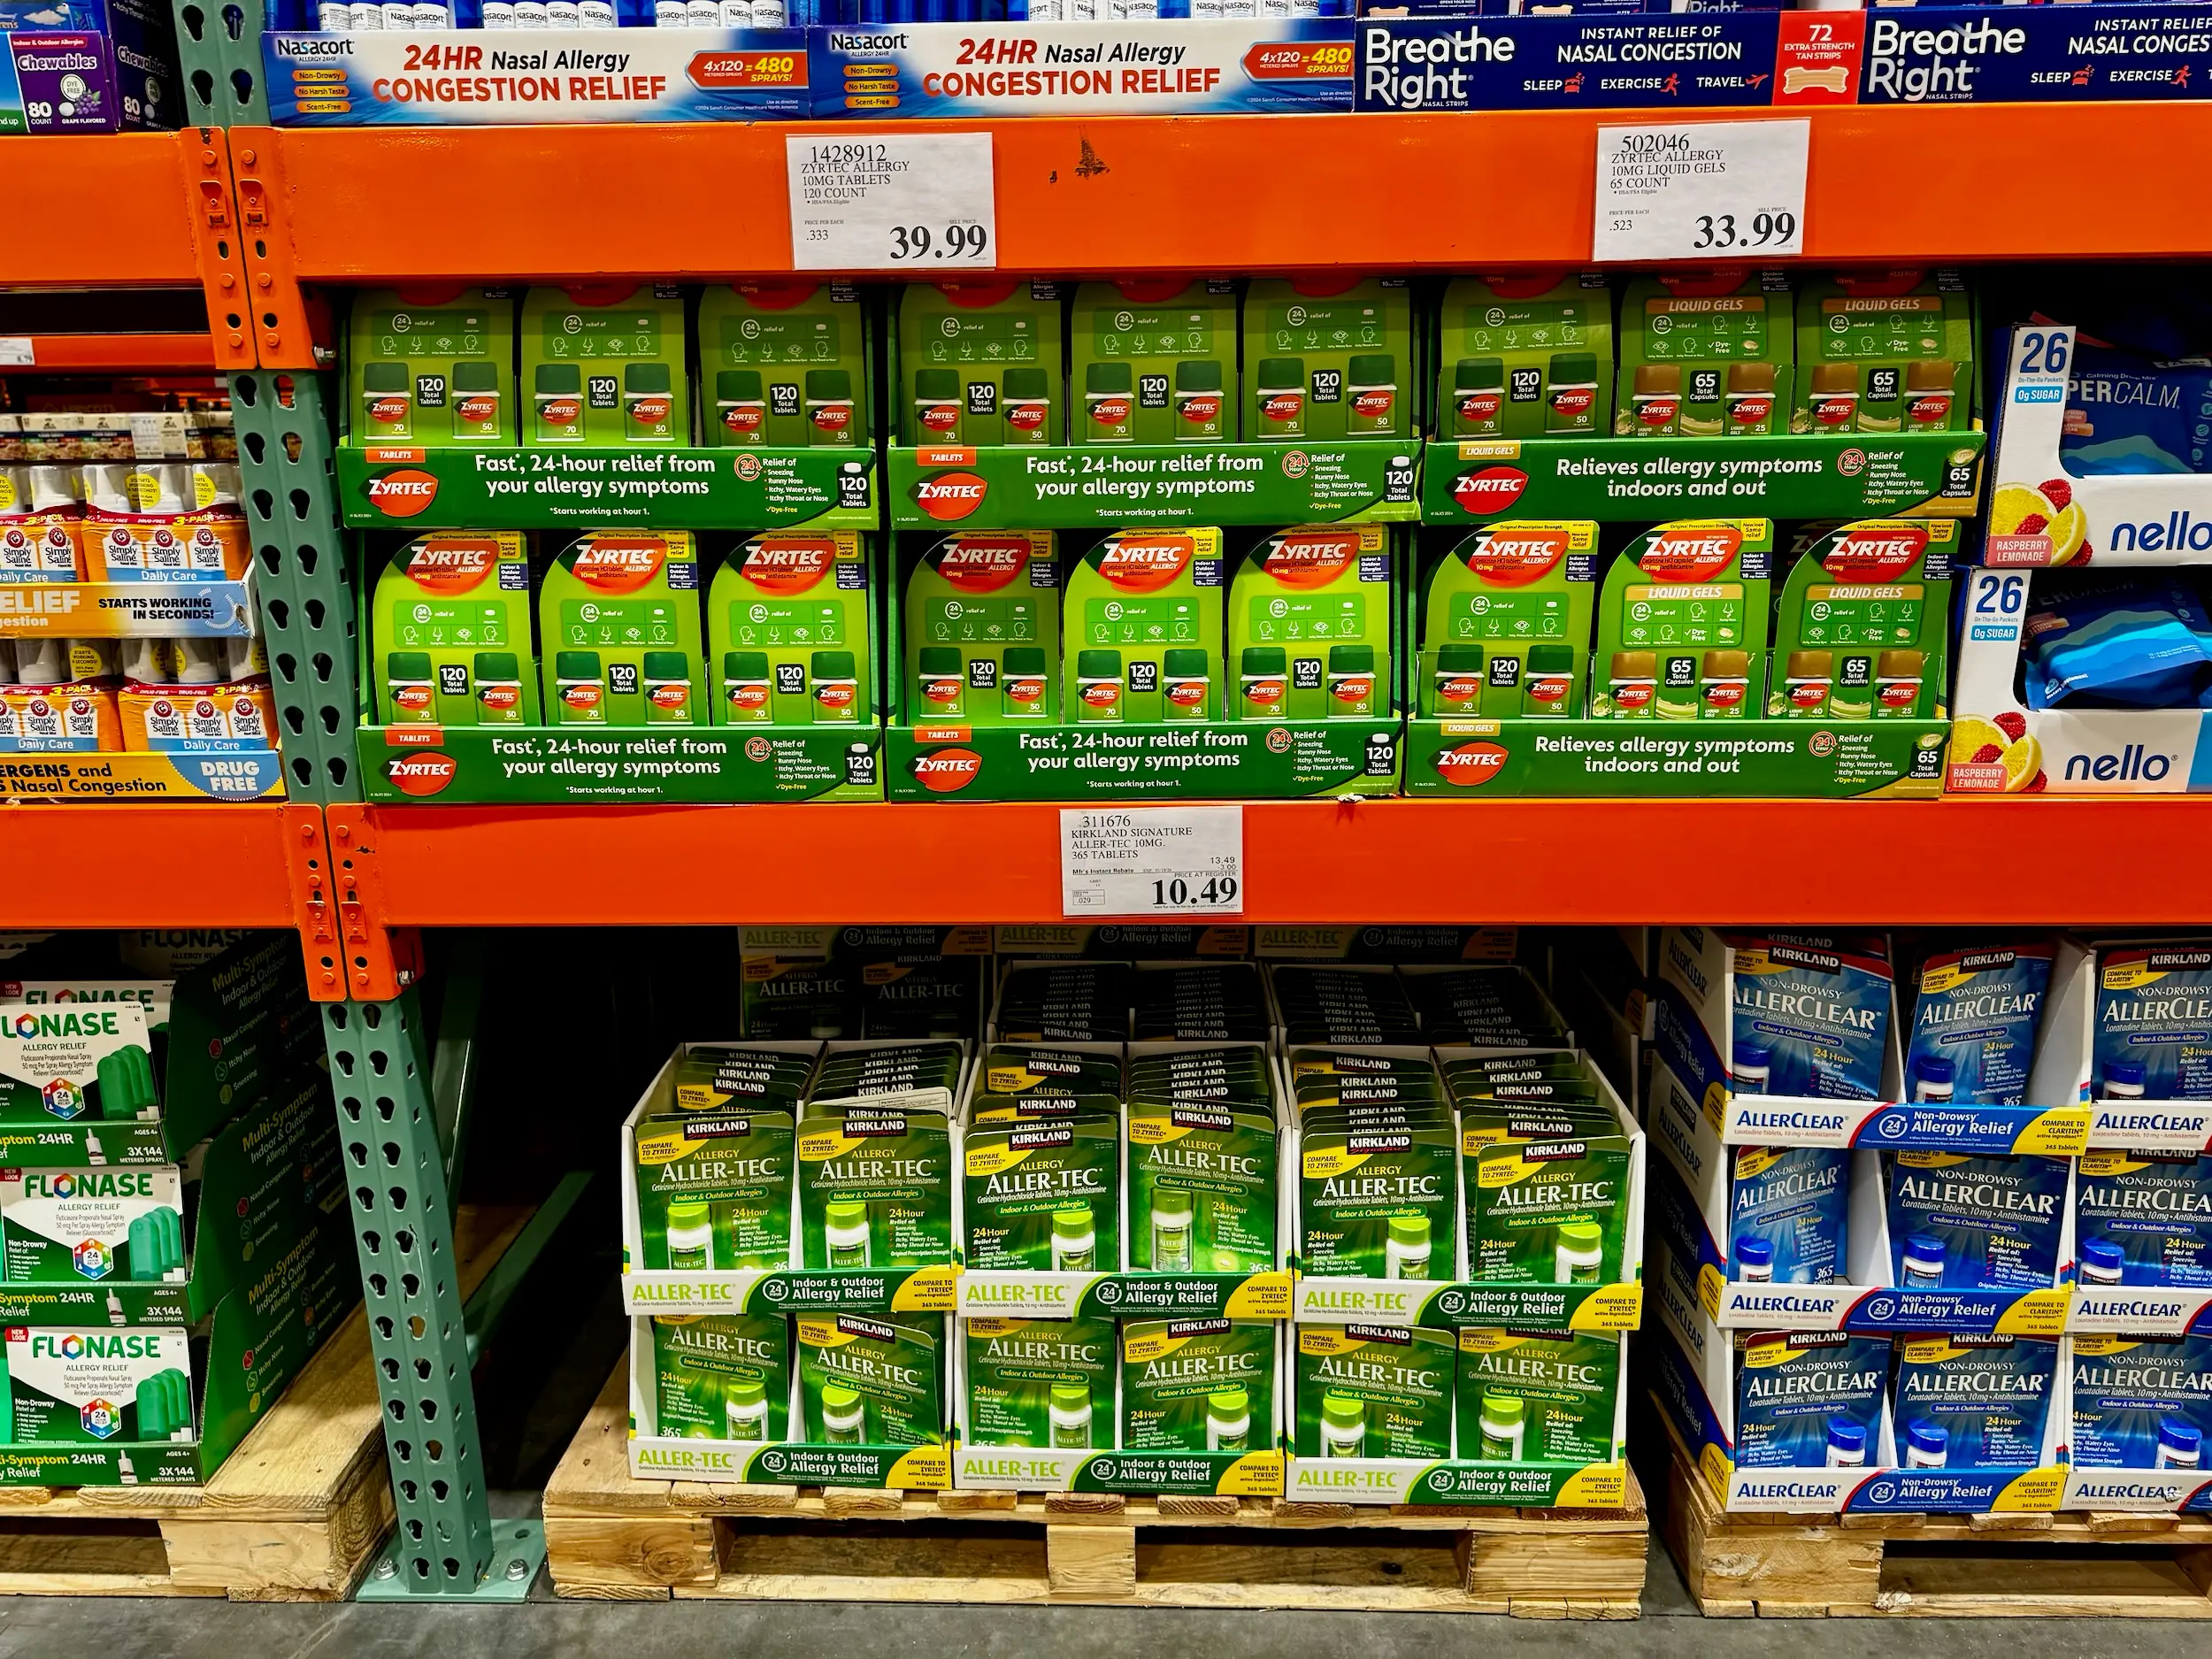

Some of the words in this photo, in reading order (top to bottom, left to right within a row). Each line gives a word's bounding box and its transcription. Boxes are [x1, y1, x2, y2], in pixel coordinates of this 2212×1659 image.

[1581, 27, 1644, 40] INSTANT
[1648, 27, 1699, 38] RELIEF
[1702, 26, 1722, 37] OF
[1809, 25, 1832, 42] 72
[278, 39, 353, 57] Nasacort
[831, 34, 907, 51] Nasacort
[1365, 26, 1515, 64] Breathe
[403, 44, 482, 72] 24HR
[491, 50, 547, 71] Nasal
[554, 50, 630, 73] Allergy
[1557, 43, 1617, 63] NASAL
[1622, 42, 1741, 62] CONGESTION
[18, 53, 97, 71] Chewables
[703, 60, 743, 73] 4x120
[754, 58, 795, 74] 480
[750, 73, 793, 83] SPRAYS!
[1524, 80, 1563, 91] SLEEP
[1601, 77, 1662, 89] EXERCISE
[1697, 76, 1745, 88] TRAVEL
[373, 79, 561, 103] CONGESTION
[571, 76, 665, 101] RELIEF
[1365, 64, 1467, 109] Right
[28, 102, 52, 118] 80
[1621, 134, 1690, 153] 502046
[811, 144, 887, 163] 1428912
[1611, 153, 1661, 164] ZYRTEC
[1665, 150, 1724, 162] ALLERGY
[802, 163, 849, 173] ZYRTEC
[854, 161, 910, 173] ALLERGY
[1612, 166, 1643, 176] 10MG
[1647, 165, 1690, 175] LIQUID
[1695, 163, 1725, 173] GELS
[803, 176, 833, 186] 10MG
[838, 174, 891, 185] TABLETS
[1610, 179, 1623, 189] 65
[1627, 178, 1670, 188] COUNT
[803, 188, 821, 198] 120
[825, 188, 867, 198] COUNT
[1609, 220, 1632, 231] .523
[1694, 212, 1795, 249] 33.99
[807, 230, 828, 241] .333
[890, 226, 987, 259] 39.99
[2019, 333, 2069, 373] 26
[2018, 390, 2029, 401] 0g
[2032, 389, 2060, 400] SUGAR
[1466, 448, 1494, 457] LIQUID
[1495, 447, 1514, 456] GELS
[530, 455, 606, 472] 24-hour
[611, 454, 664, 473] relief
[668, 455, 716, 472] from
[1556, 458, 1639, 477] Relieves
[1643, 457, 1716, 480] allergy
[1719, 457, 1823, 479] symptoms
[368, 480, 431, 495] ZYRTEC
[486, 480, 529, 497] your
[534, 476, 603, 497] allergy
[609, 479, 710, 498] symptoms
[839, 477, 867, 491] 120
[1609, 480, 1683, 497] indoors
[1688, 480, 1729, 496] and
[1733, 480, 1766, 495] out
[579, 507, 610, 517] working
[109, 545, 137, 560] Simply
[1472, 536, 1555, 557] ZYRTEC
[1996, 541, 2047, 551] RASPBERRY
[1997, 551, 2044, 562] LEMONADE
[142, 571, 169, 582] Daily
[172, 572, 196, 581] Care
[98, 598, 148, 608] STARTS
[150, 598, 211, 608] WORKING
[133, 611, 146, 619] IN
[149, 610, 214, 619] SECONDS!
[1671, 661, 1691, 673] 65
[201, 762, 259, 776] DRUG
[2064, 744, 2170, 780] nello
[13, 780, 62, 793] Nasal
[69, 778, 166, 795] Congestion
[211, 777, 257, 792] FREE
[1083, 815, 1131, 828] 311676
[1071, 829, 1127, 839] KIRKLAND
[1131, 827, 1192, 837] SIGNATURE
[1072, 840, 1131, 849] ALLER-TEC
[1135, 839, 1165, 848] 10MG.
[1091, 850, 1138, 859] TABLETS
[1152, 878, 1237, 905] 10.49
[242, 1083, 318, 1152] Multi-Symptom
[687, 1121, 748, 1133] KIRKLAND
[694, 1149, 740, 1160] ALLERGY
[661, 1158, 776, 1183] ALLER-TEC
[1936, 1170, 2021, 1187] NON-DROWSY
[1899, 1176, 2054, 1214] ALLERCLEAR
[1902, 1199, 1941, 1210] Loratadine
[1942, 1202, 1968, 1215] Tablets,
[1997, 1210, 2049, 1224] Antihistamine
[793, 1279, 826, 1288] Indoor
[830, 1278, 838, 1287] &
[841, 1277, 884, 1286] Outdoor
[793, 1288, 841, 1301] Allergy
[845, 1286, 884, 1299] Relief
[33, 1334, 161, 1360] FLONASE
[71, 1455, 106, 1464] 24HR
